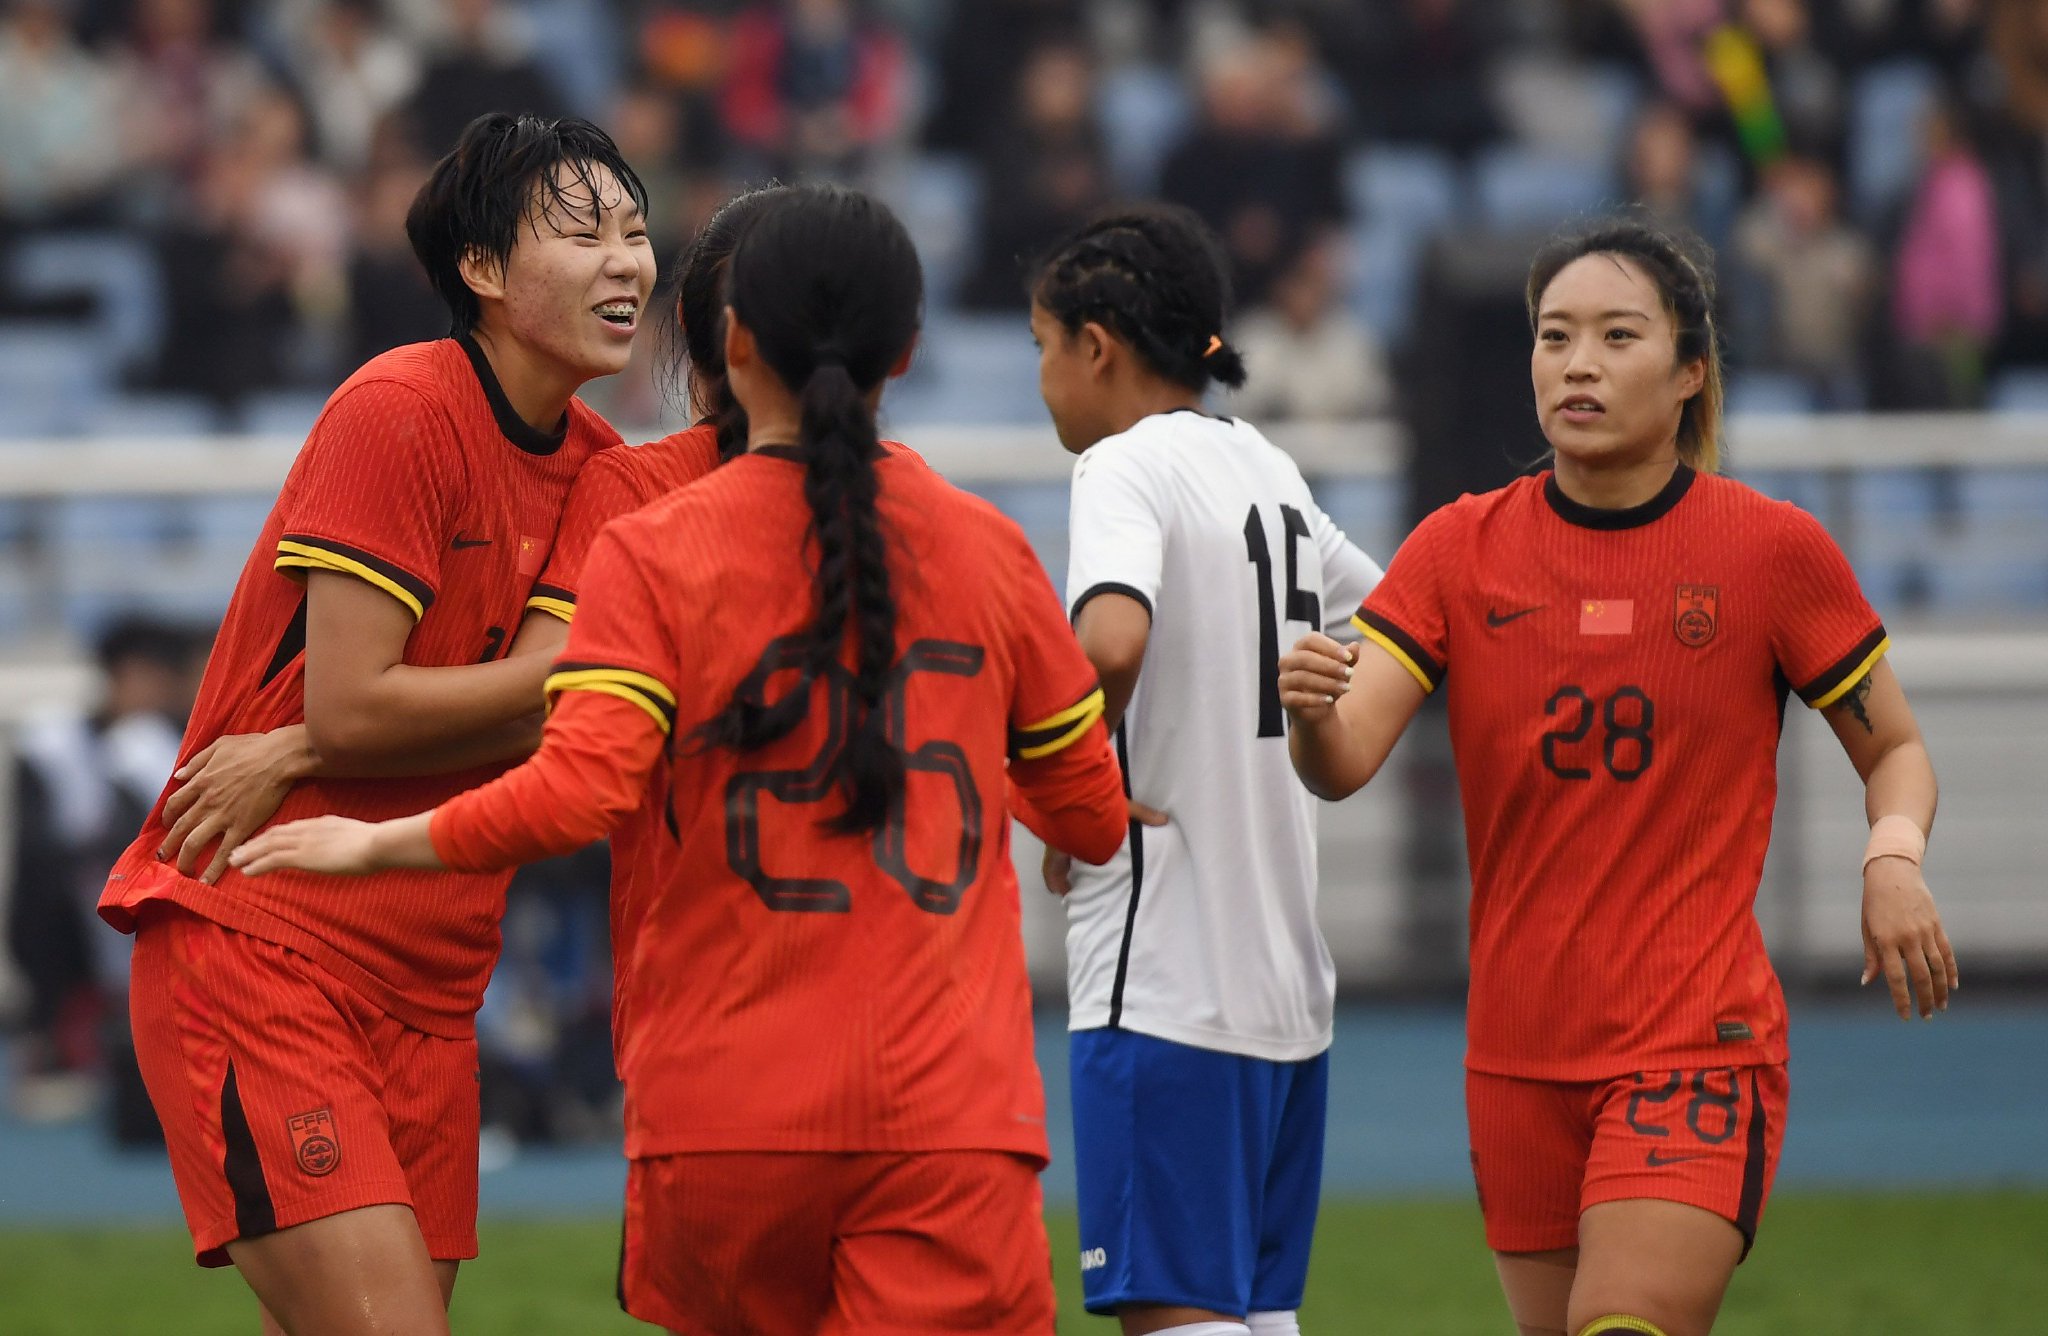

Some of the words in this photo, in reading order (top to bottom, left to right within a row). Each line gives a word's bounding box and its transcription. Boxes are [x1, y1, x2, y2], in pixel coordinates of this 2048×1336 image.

[726, 632, 985, 914] 26
[1541, 686, 1654, 781] 28
[291, 1112, 328, 1131] CFA
[1625, 1067, 1740, 1144] 28
